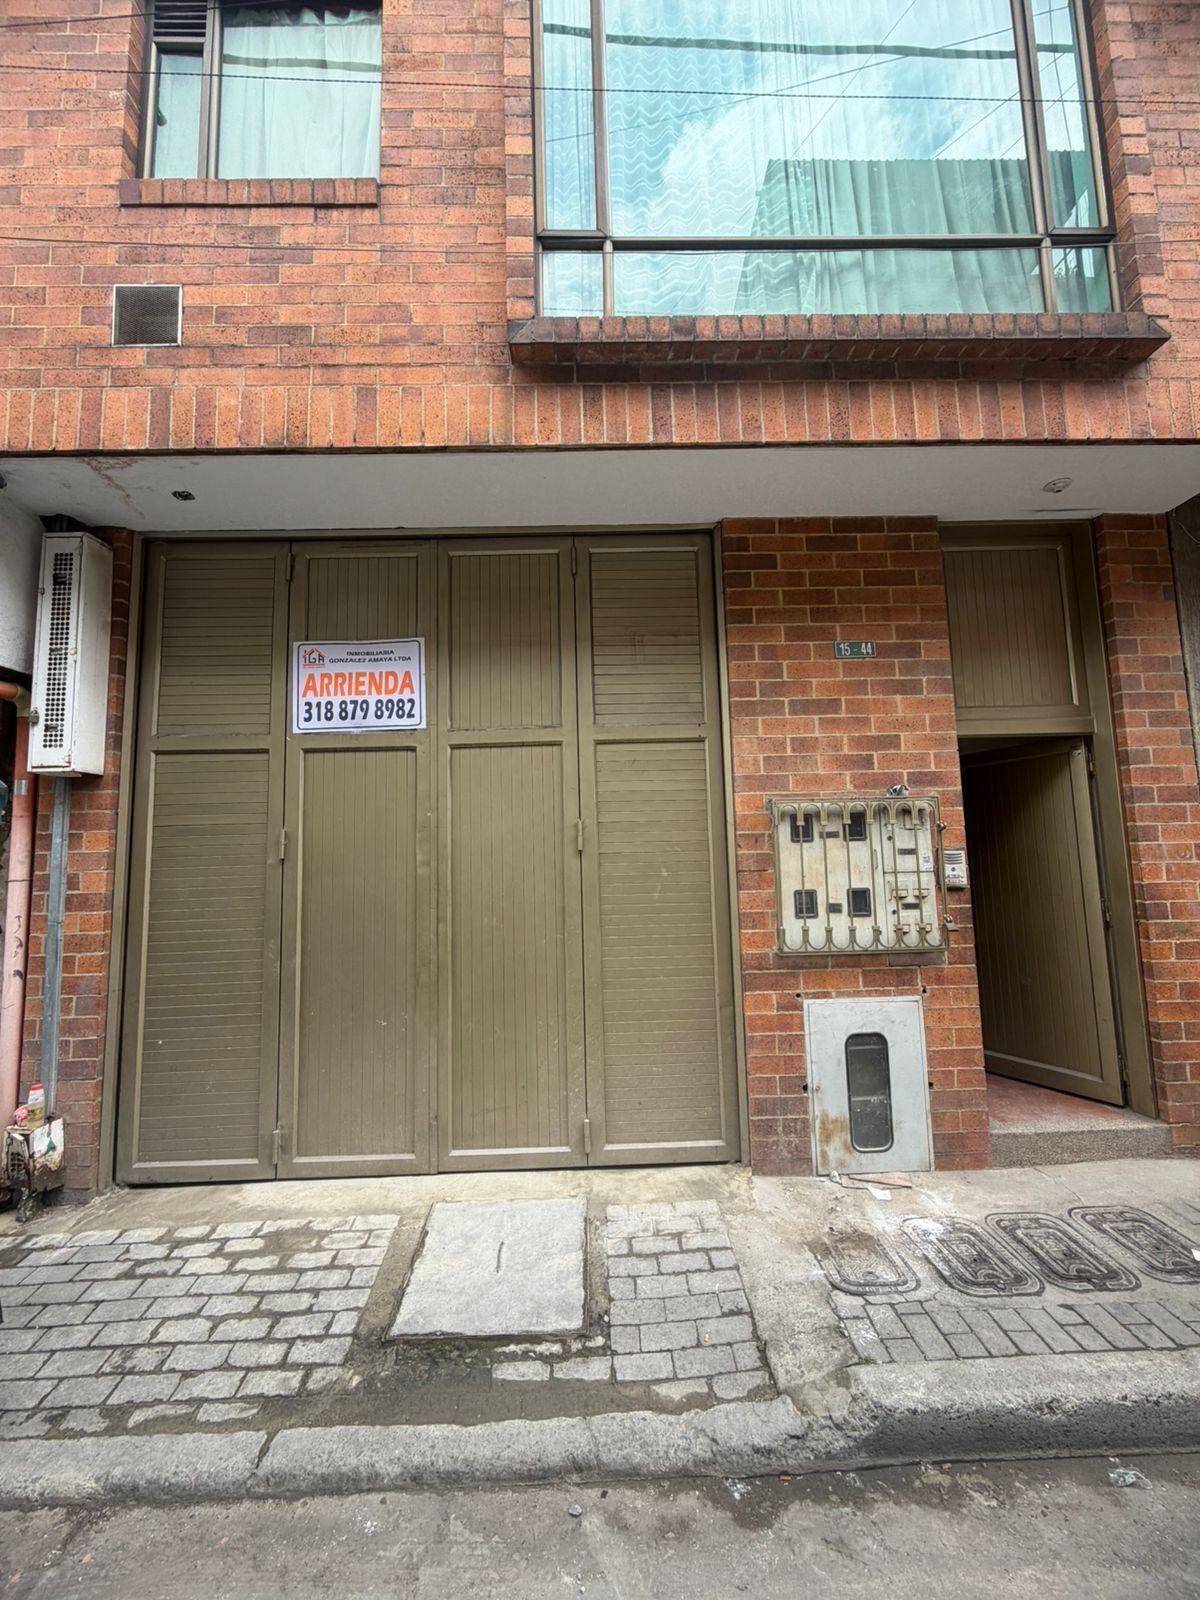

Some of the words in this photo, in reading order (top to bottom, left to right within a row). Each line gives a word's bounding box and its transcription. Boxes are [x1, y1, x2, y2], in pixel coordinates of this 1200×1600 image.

[839, 643, 850, 655] 15
[861, 642, 872, 654] 44
[302, 671, 415, 698] ARRIENDA
[303, 701, 334, 722] 318
[338, 699, 370, 721] 879
[374, 698, 416, 720] 8982
